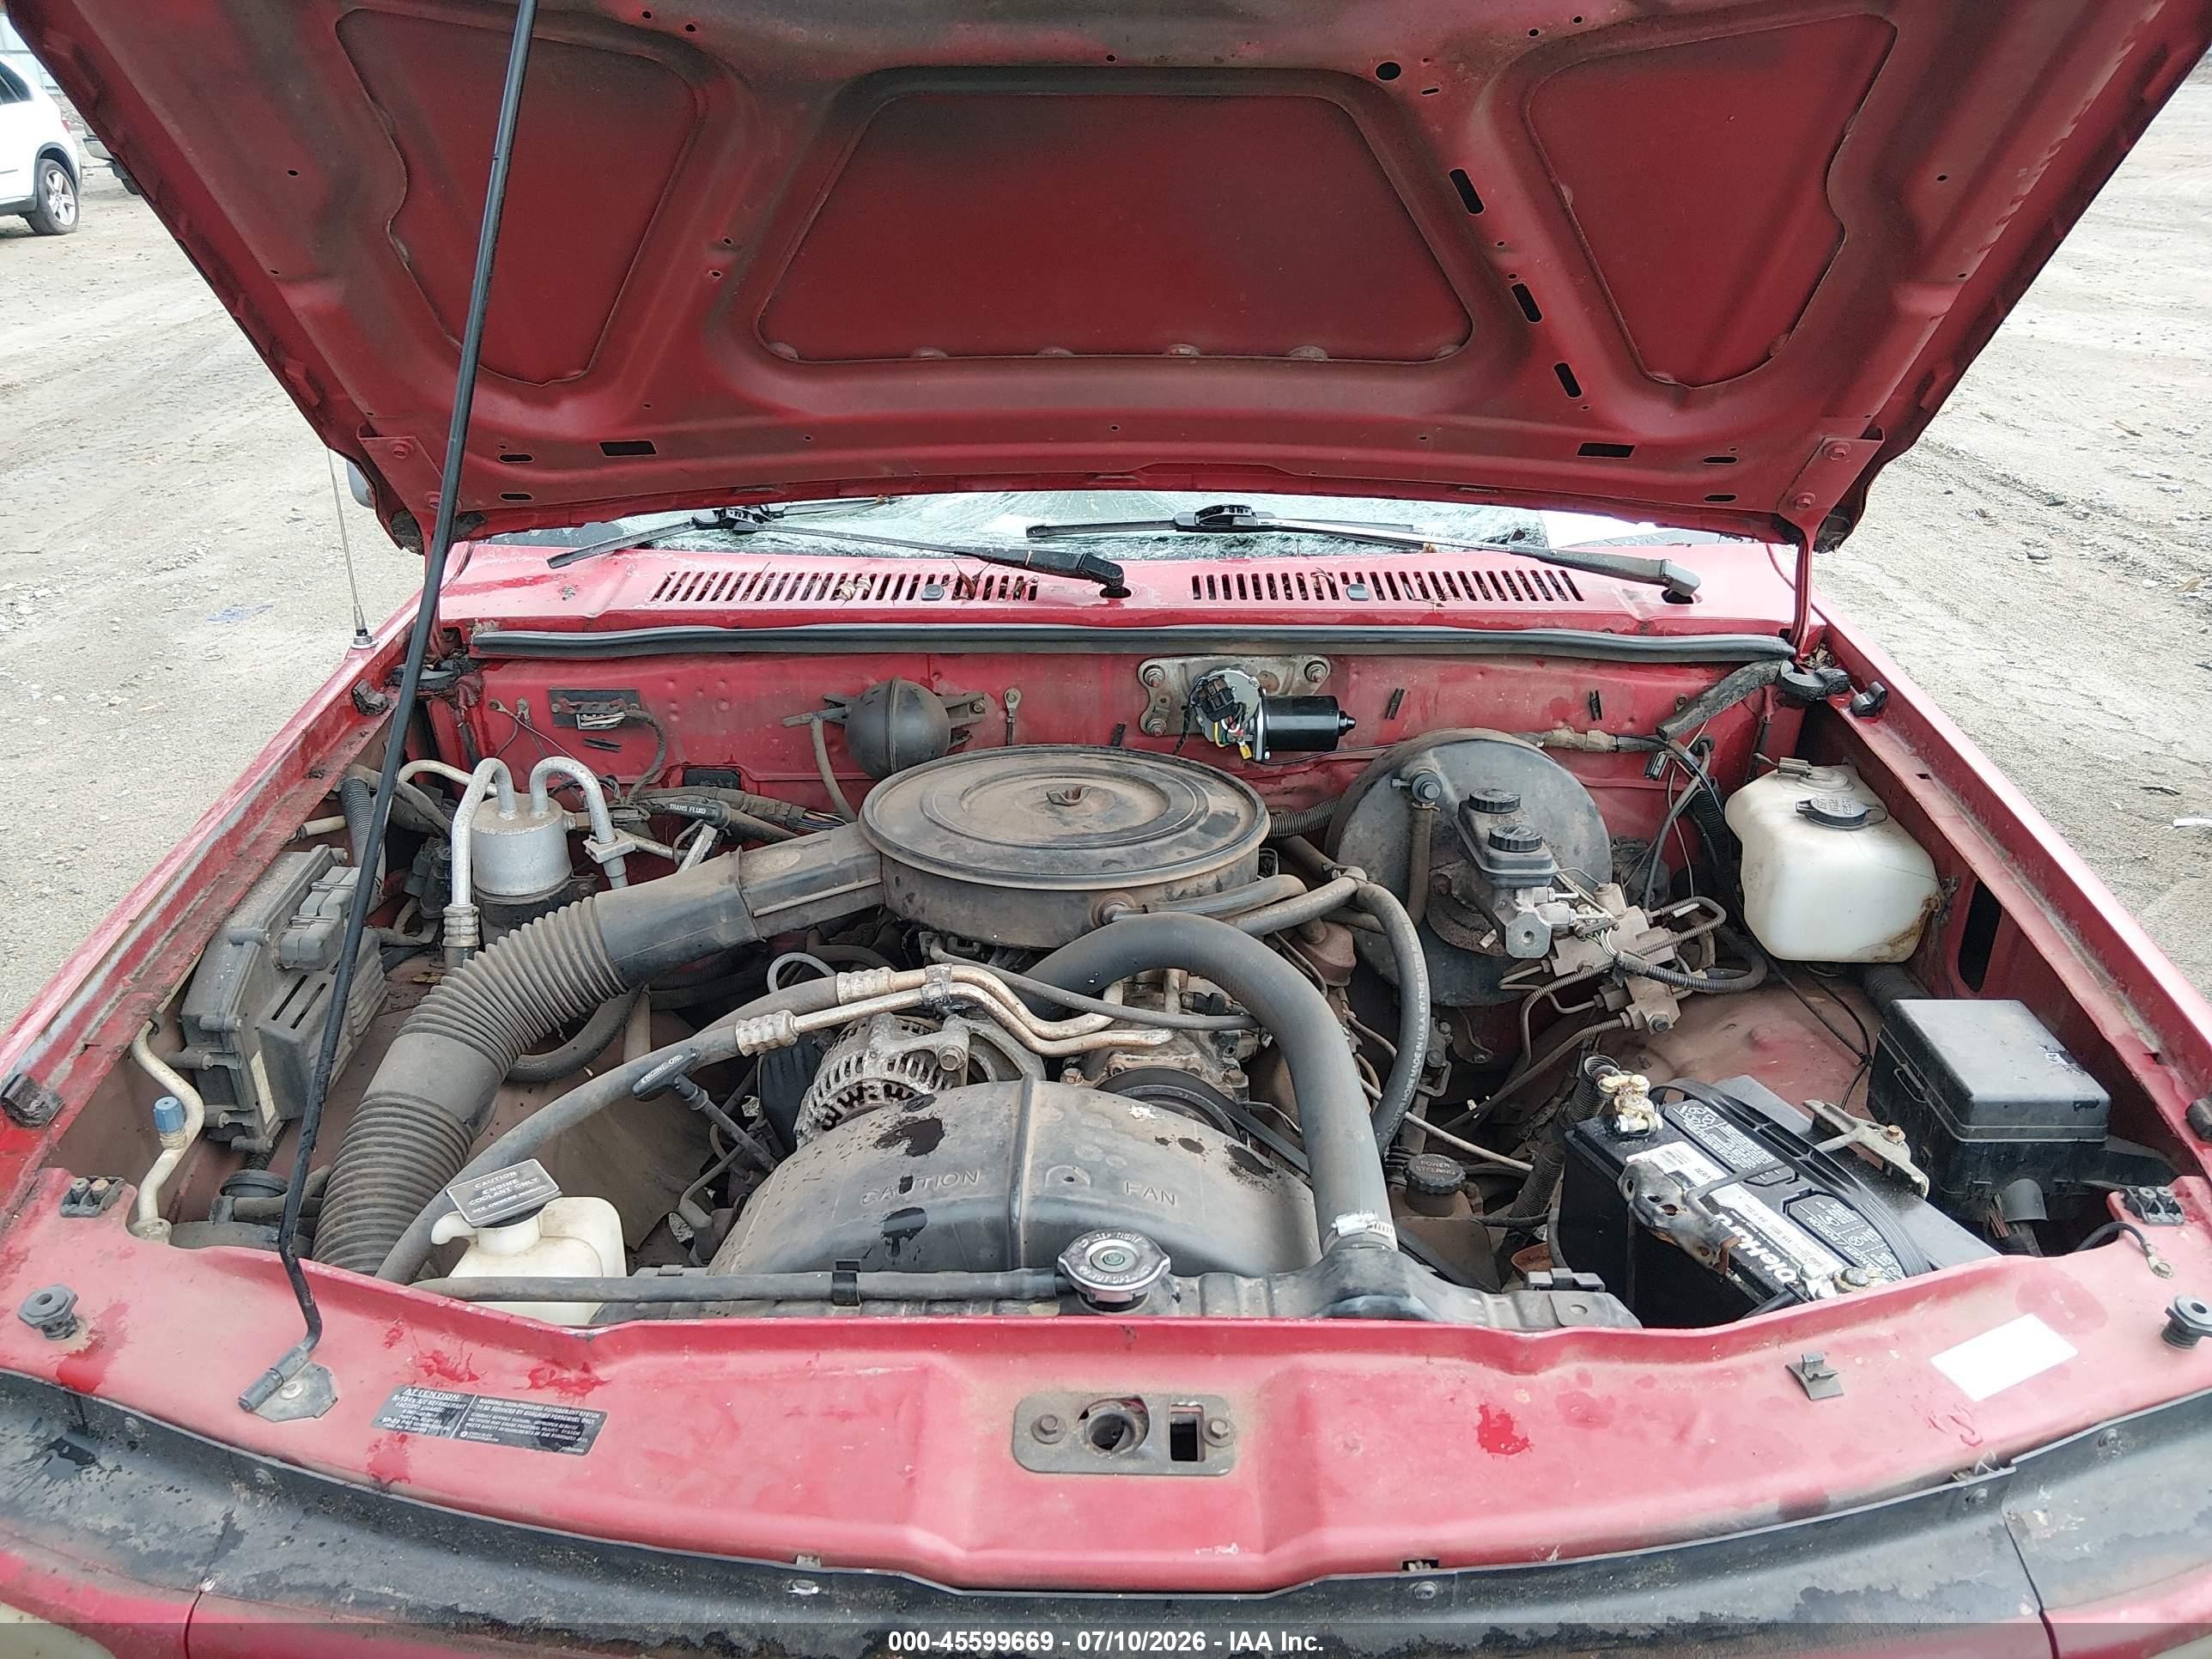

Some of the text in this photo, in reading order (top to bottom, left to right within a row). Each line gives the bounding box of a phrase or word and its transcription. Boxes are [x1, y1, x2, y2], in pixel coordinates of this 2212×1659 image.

[689, 805, 706, 814] FLUID
[1417, 981, 1425, 999] THE
[1419, 1000, 1426, 1012] BY
[1416, 1042, 1424, 1051] IN
[641, 1054, 684, 1085] ENGINE OIL
[1410, 1052, 1422, 1077] MADE
[1401, 1078, 1416, 1101] HOSE
[1416, 1166, 1456, 1176] STEERING
[1419, 1160, 1450, 1169] POWER
[474, 1170, 517, 1188] CAUTION
[483, 1178, 519, 1194] ENGINE
[469, 1177, 538, 1205] COOLANT ONLY
[1125, 1180, 1177, 1206] FAN
[1807, 1217, 1841, 1243] POISON
[401, 1388, 460, 1401] ATTENTION
